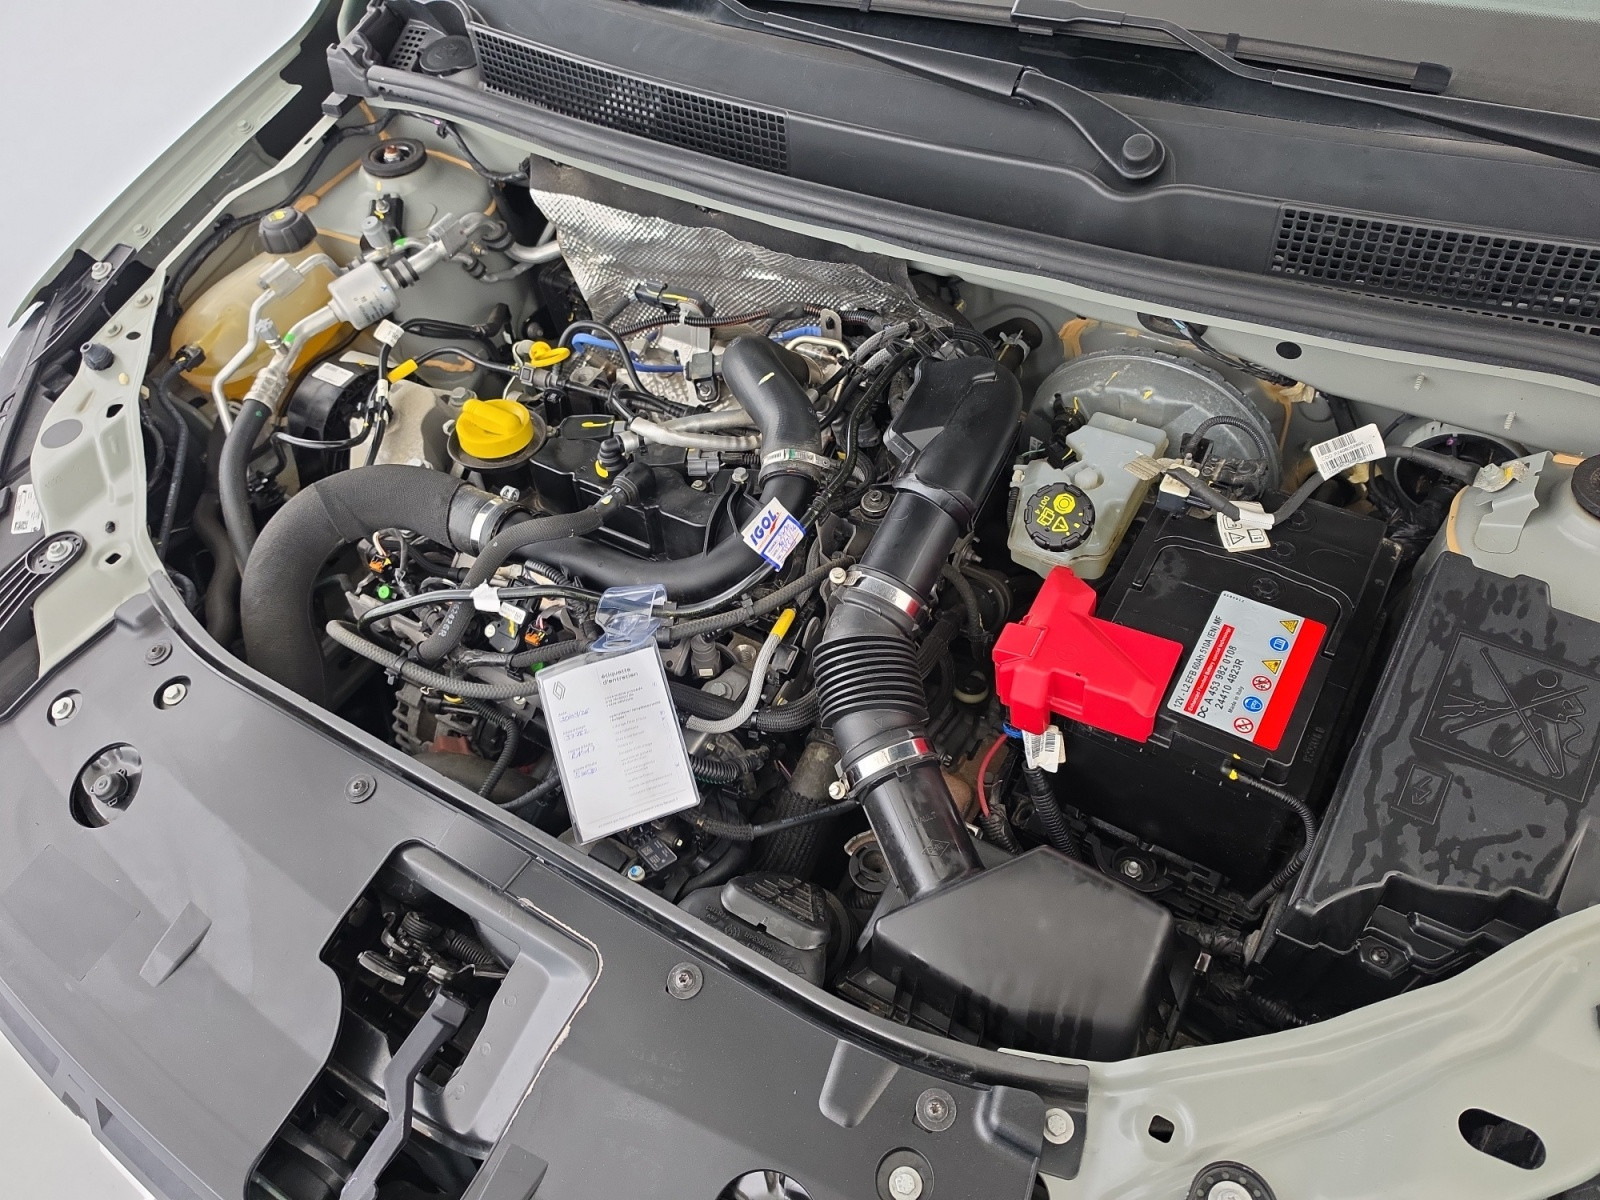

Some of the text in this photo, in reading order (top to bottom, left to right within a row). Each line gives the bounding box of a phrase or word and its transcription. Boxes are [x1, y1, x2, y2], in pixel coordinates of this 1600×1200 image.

[1039, 496, 1050, 510] DOT
[750, 510, 777, 546] IGOL
[1212, 615, 1222, 626] MF
[1206, 626, 1221, 640] (EN)
[1200, 639, 1212, 654] 510A
[1192, 654, 1206, 670] 60Ah
[1185, 670, 1197, 684] EFB
[1197, 706, 1208, 718] DC
[1208, 681, 1220, 696] 453
[1215, 665, 1228, 680] 982
[1222, 645, 1237, 664] 0108
[1214, 658, 1244, 710] 24410 4823R
[1181, 684, 1191, 692] L2
[1174, 696, 1184, 708] 12V
[1228, 701, 1236, 713] Made
[1236, 686, 1244, 696] Italy
